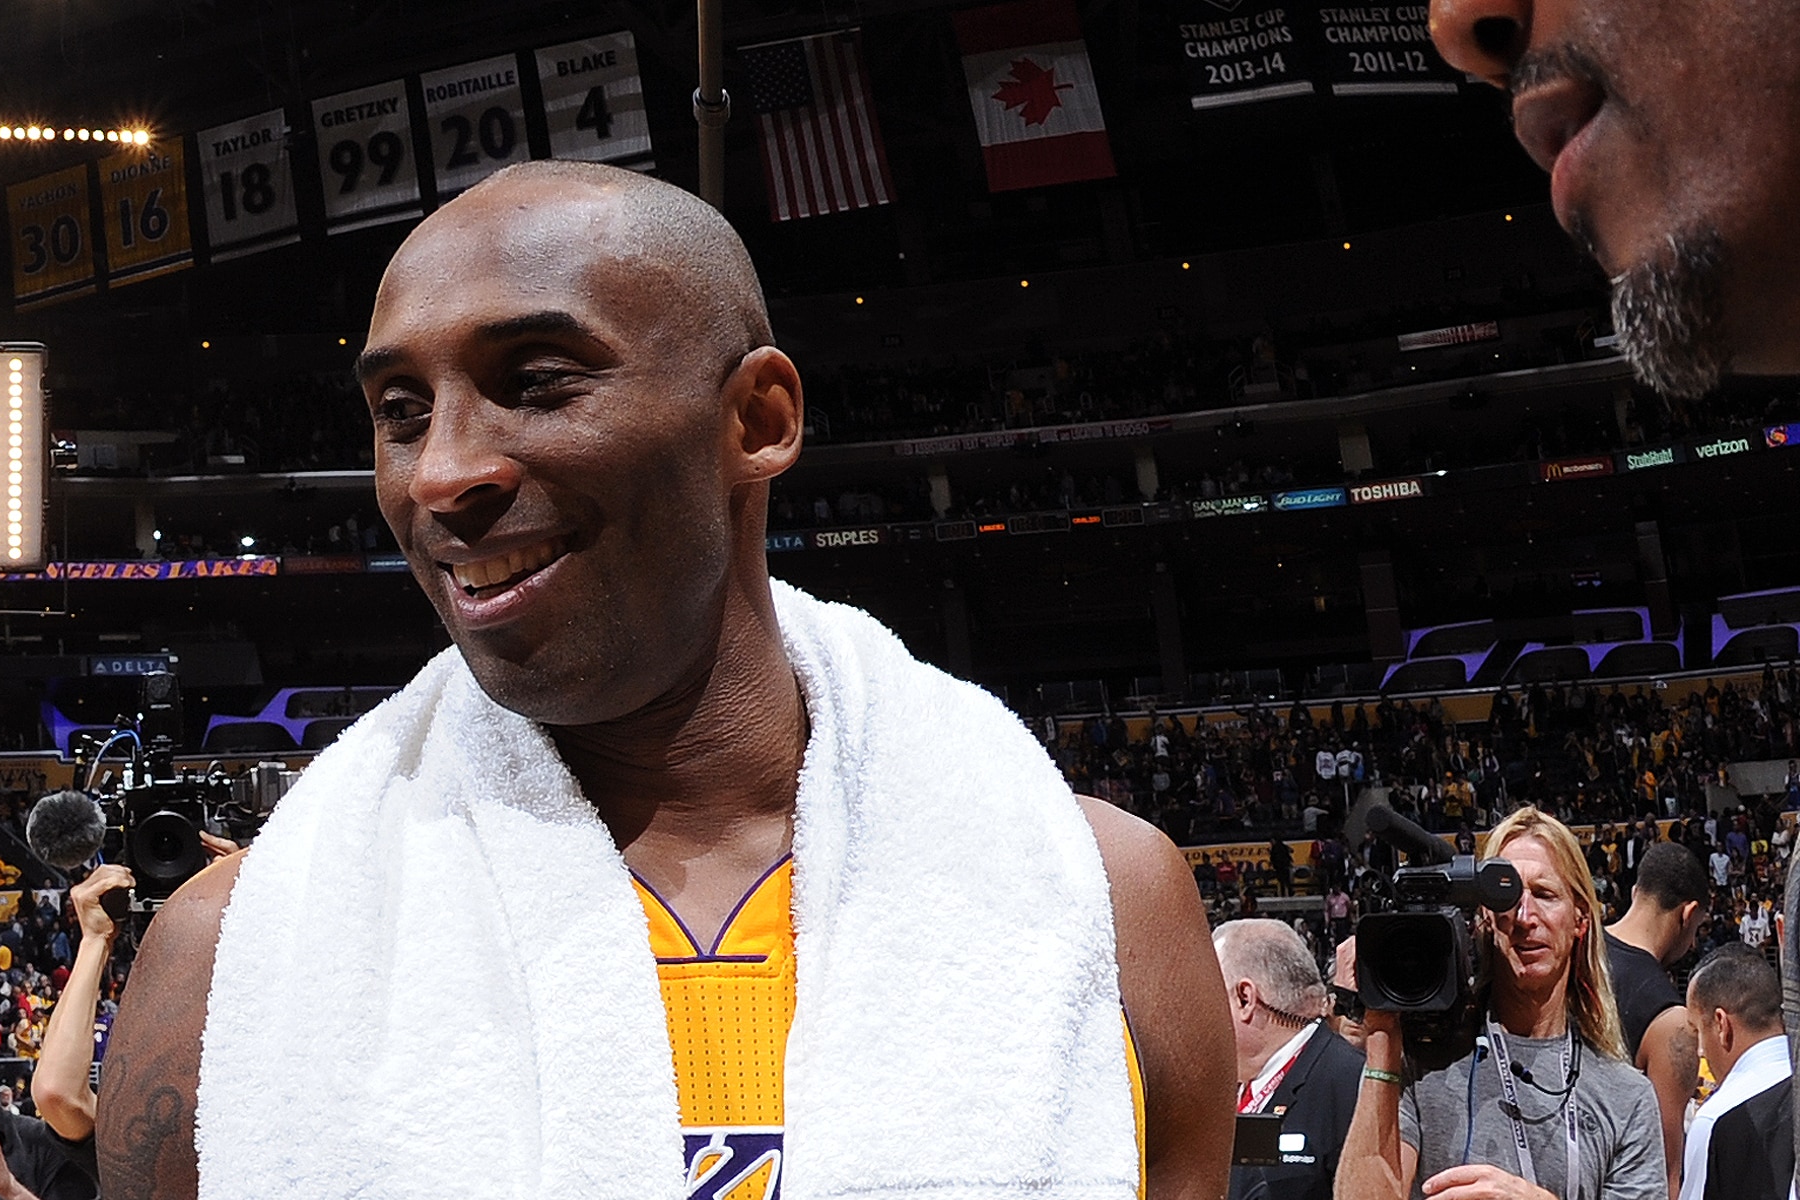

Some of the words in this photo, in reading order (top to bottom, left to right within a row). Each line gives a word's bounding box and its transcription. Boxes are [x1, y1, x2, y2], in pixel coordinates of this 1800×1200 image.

[1178, 17, 1250, 40] STANLEY
[1255, 7, 1287, 28] CUP
[1319, 8, 1392, 25] STANLEY
[1398, 5, 1429, 21] CUP
[1184, 26, 1293, 58] CHAMPIONS
[557, 50, 617, 77] BLAKE
[1205, 51, 1287, 84] 2013-14
[1350, 50, 1429, 73] 2011-12
[426, 70, 516, 103] ROBITAILLE
[321, 97, 399, 128] GRETZKY
[576, 86, 613, 139] 4
[212, 128, 273, 157] TAYLOR
[441, 107, 516, 170] 20
[110, 155, 172, 184] DIONNE
[330, 131, 404, 195] 99
[220, 162, 276, 221] 18
[119, 187, 170, 249] 16
[19, 213, 82, 276] 30
[1626, 448, 1674, 470] StubHub!
[1696, 439, 1749, 459] verizon
[1351, 481, 1421, 501] TOSHIBA
[815, 530, 879, 548] STAPLES
[26, 561, 161, 580] NGELES
[113, 661, 168, 673] DELTA
